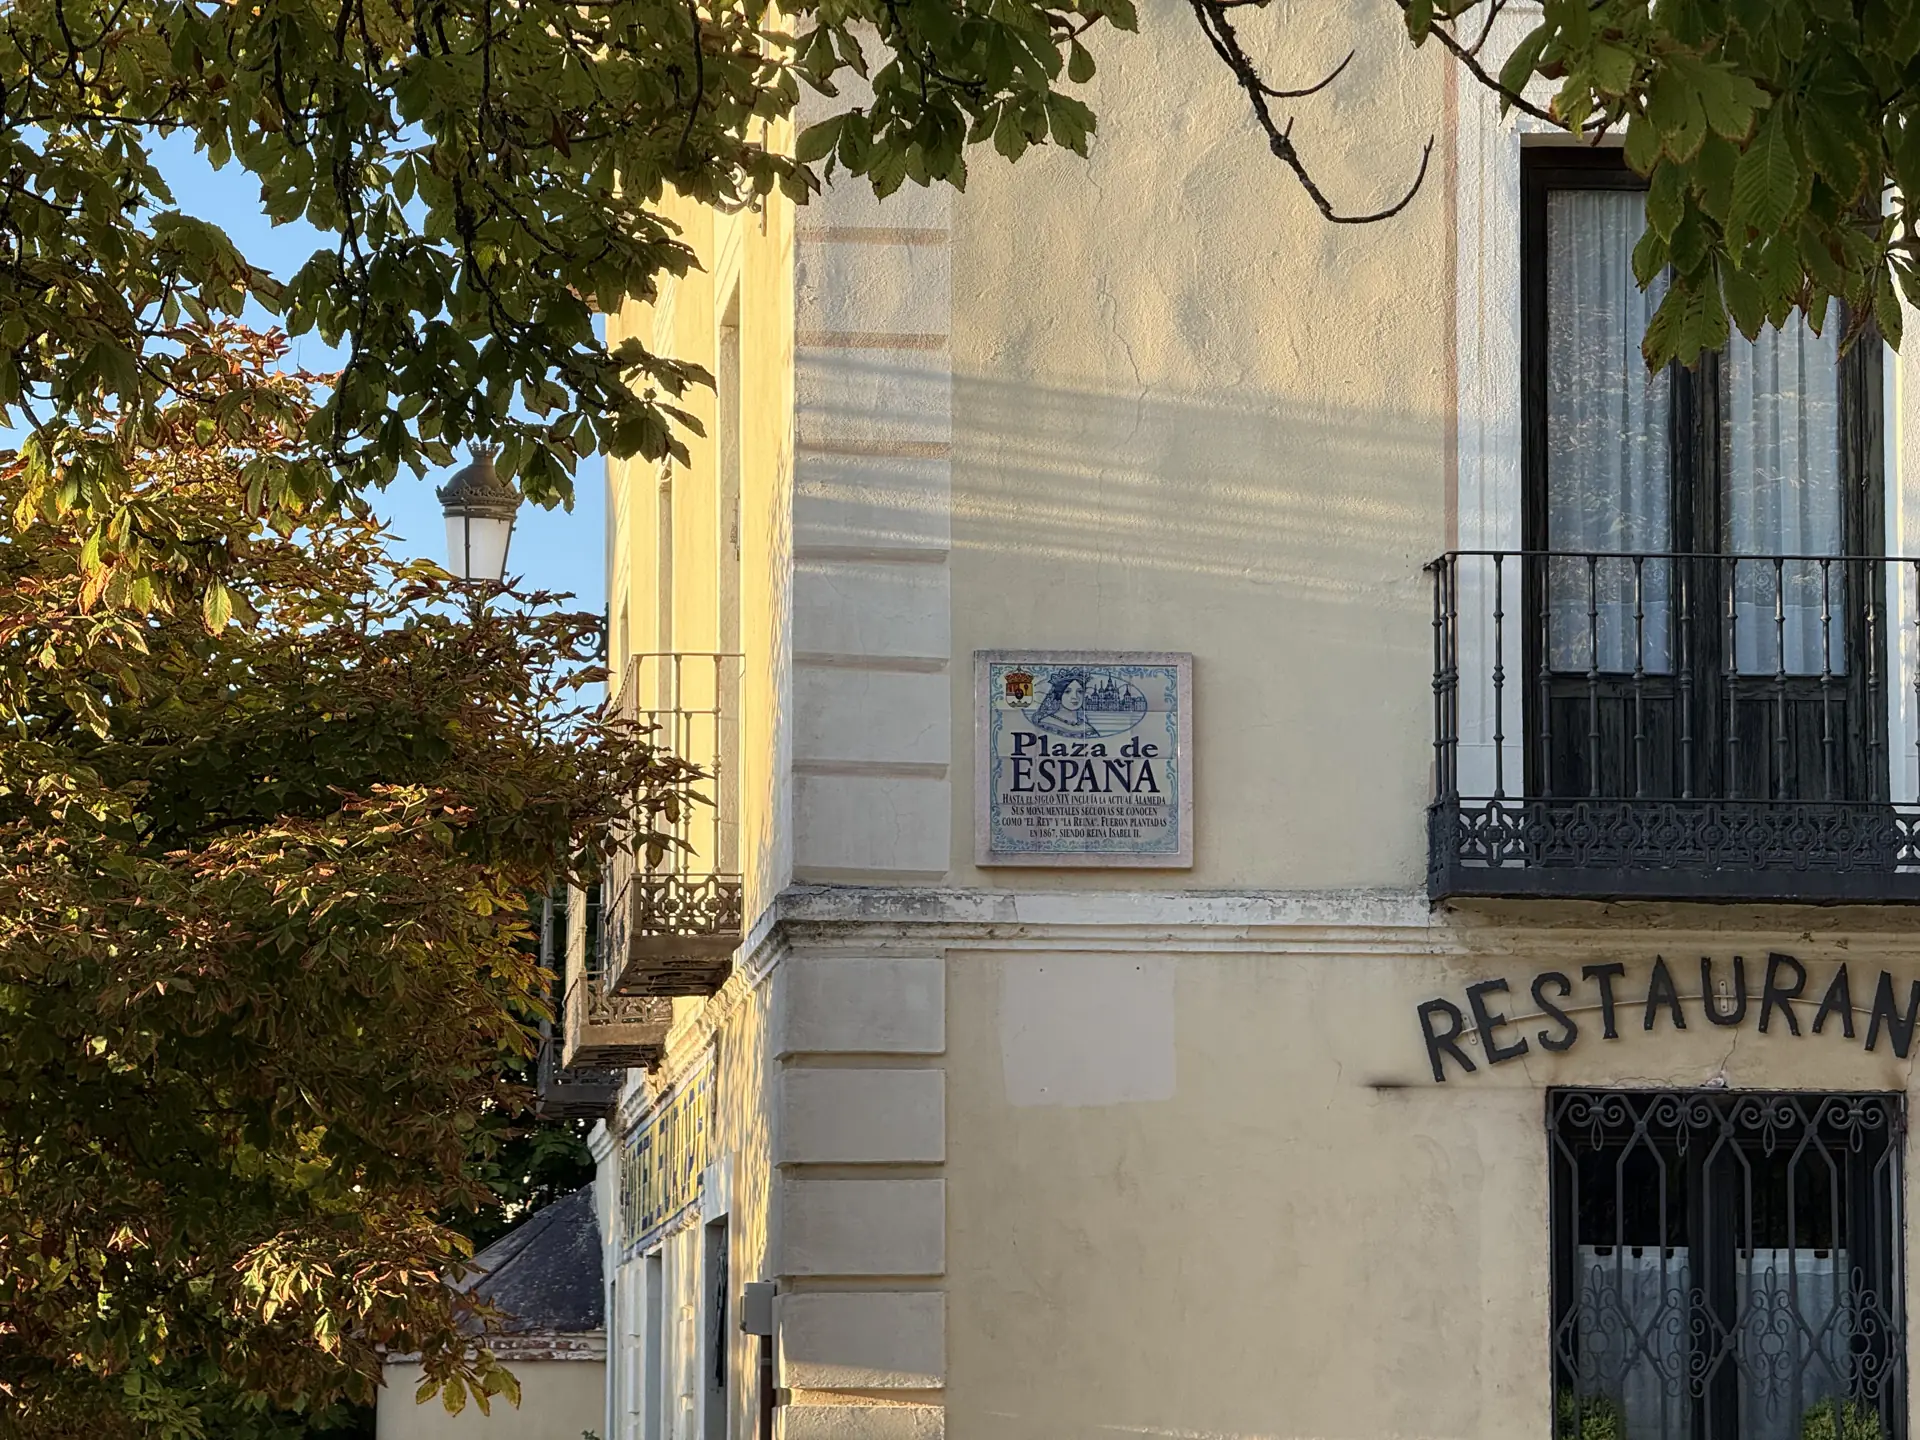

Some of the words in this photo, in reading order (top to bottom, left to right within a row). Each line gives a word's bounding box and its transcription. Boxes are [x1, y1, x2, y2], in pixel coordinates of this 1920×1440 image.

[1011, 732, 1107, 758] Plaza
[1120, 736, 1159, 758] de
[1010, 757, 1160, 793] ESPAÑA
